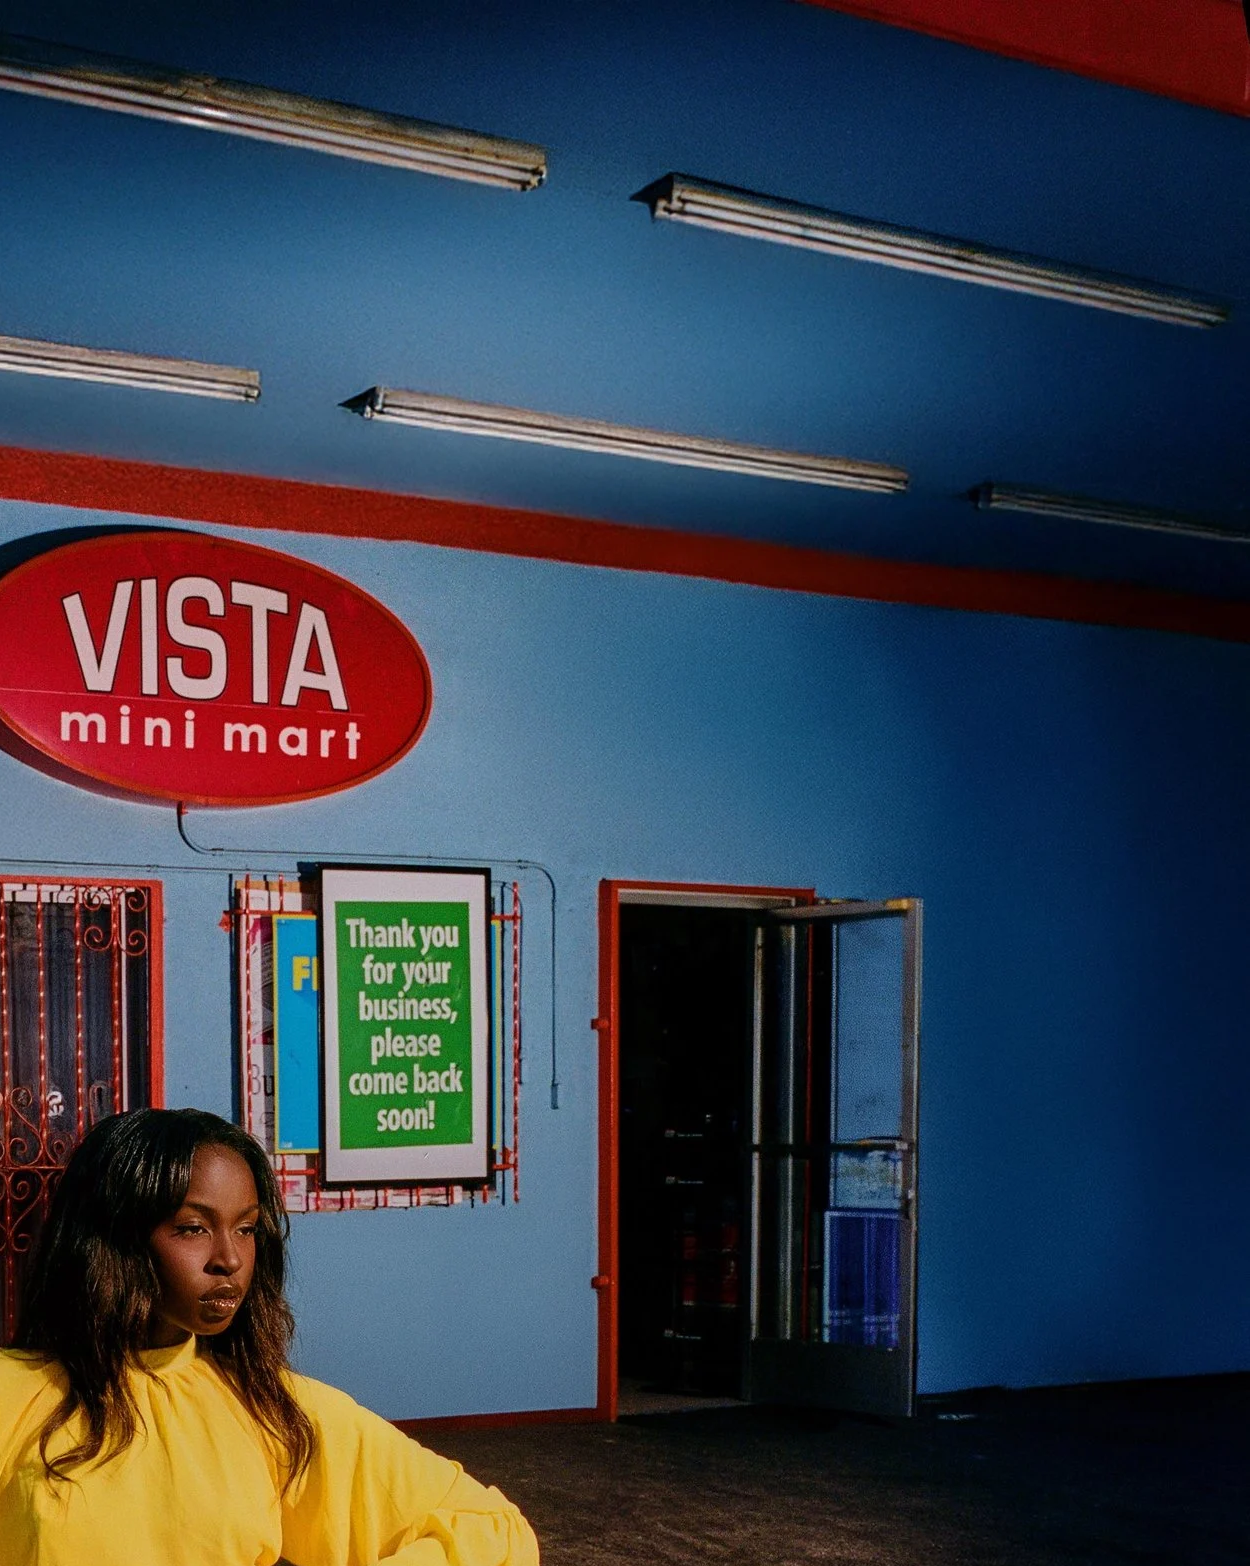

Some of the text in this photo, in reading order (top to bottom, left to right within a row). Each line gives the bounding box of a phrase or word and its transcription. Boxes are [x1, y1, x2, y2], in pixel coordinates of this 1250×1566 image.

[61, 576, 348, 710] VISTA
[60, 705, 361, 759] mini mart
[345, 918, 459, 954] Thank you
[361, 954, 451, 991] for your
[358, 991, 458, 1024] business,
[370, 1027, 441, 1065] please
[349, 1063, 463, 1095] come back
[376, 1101, 436, 1132] soon!
